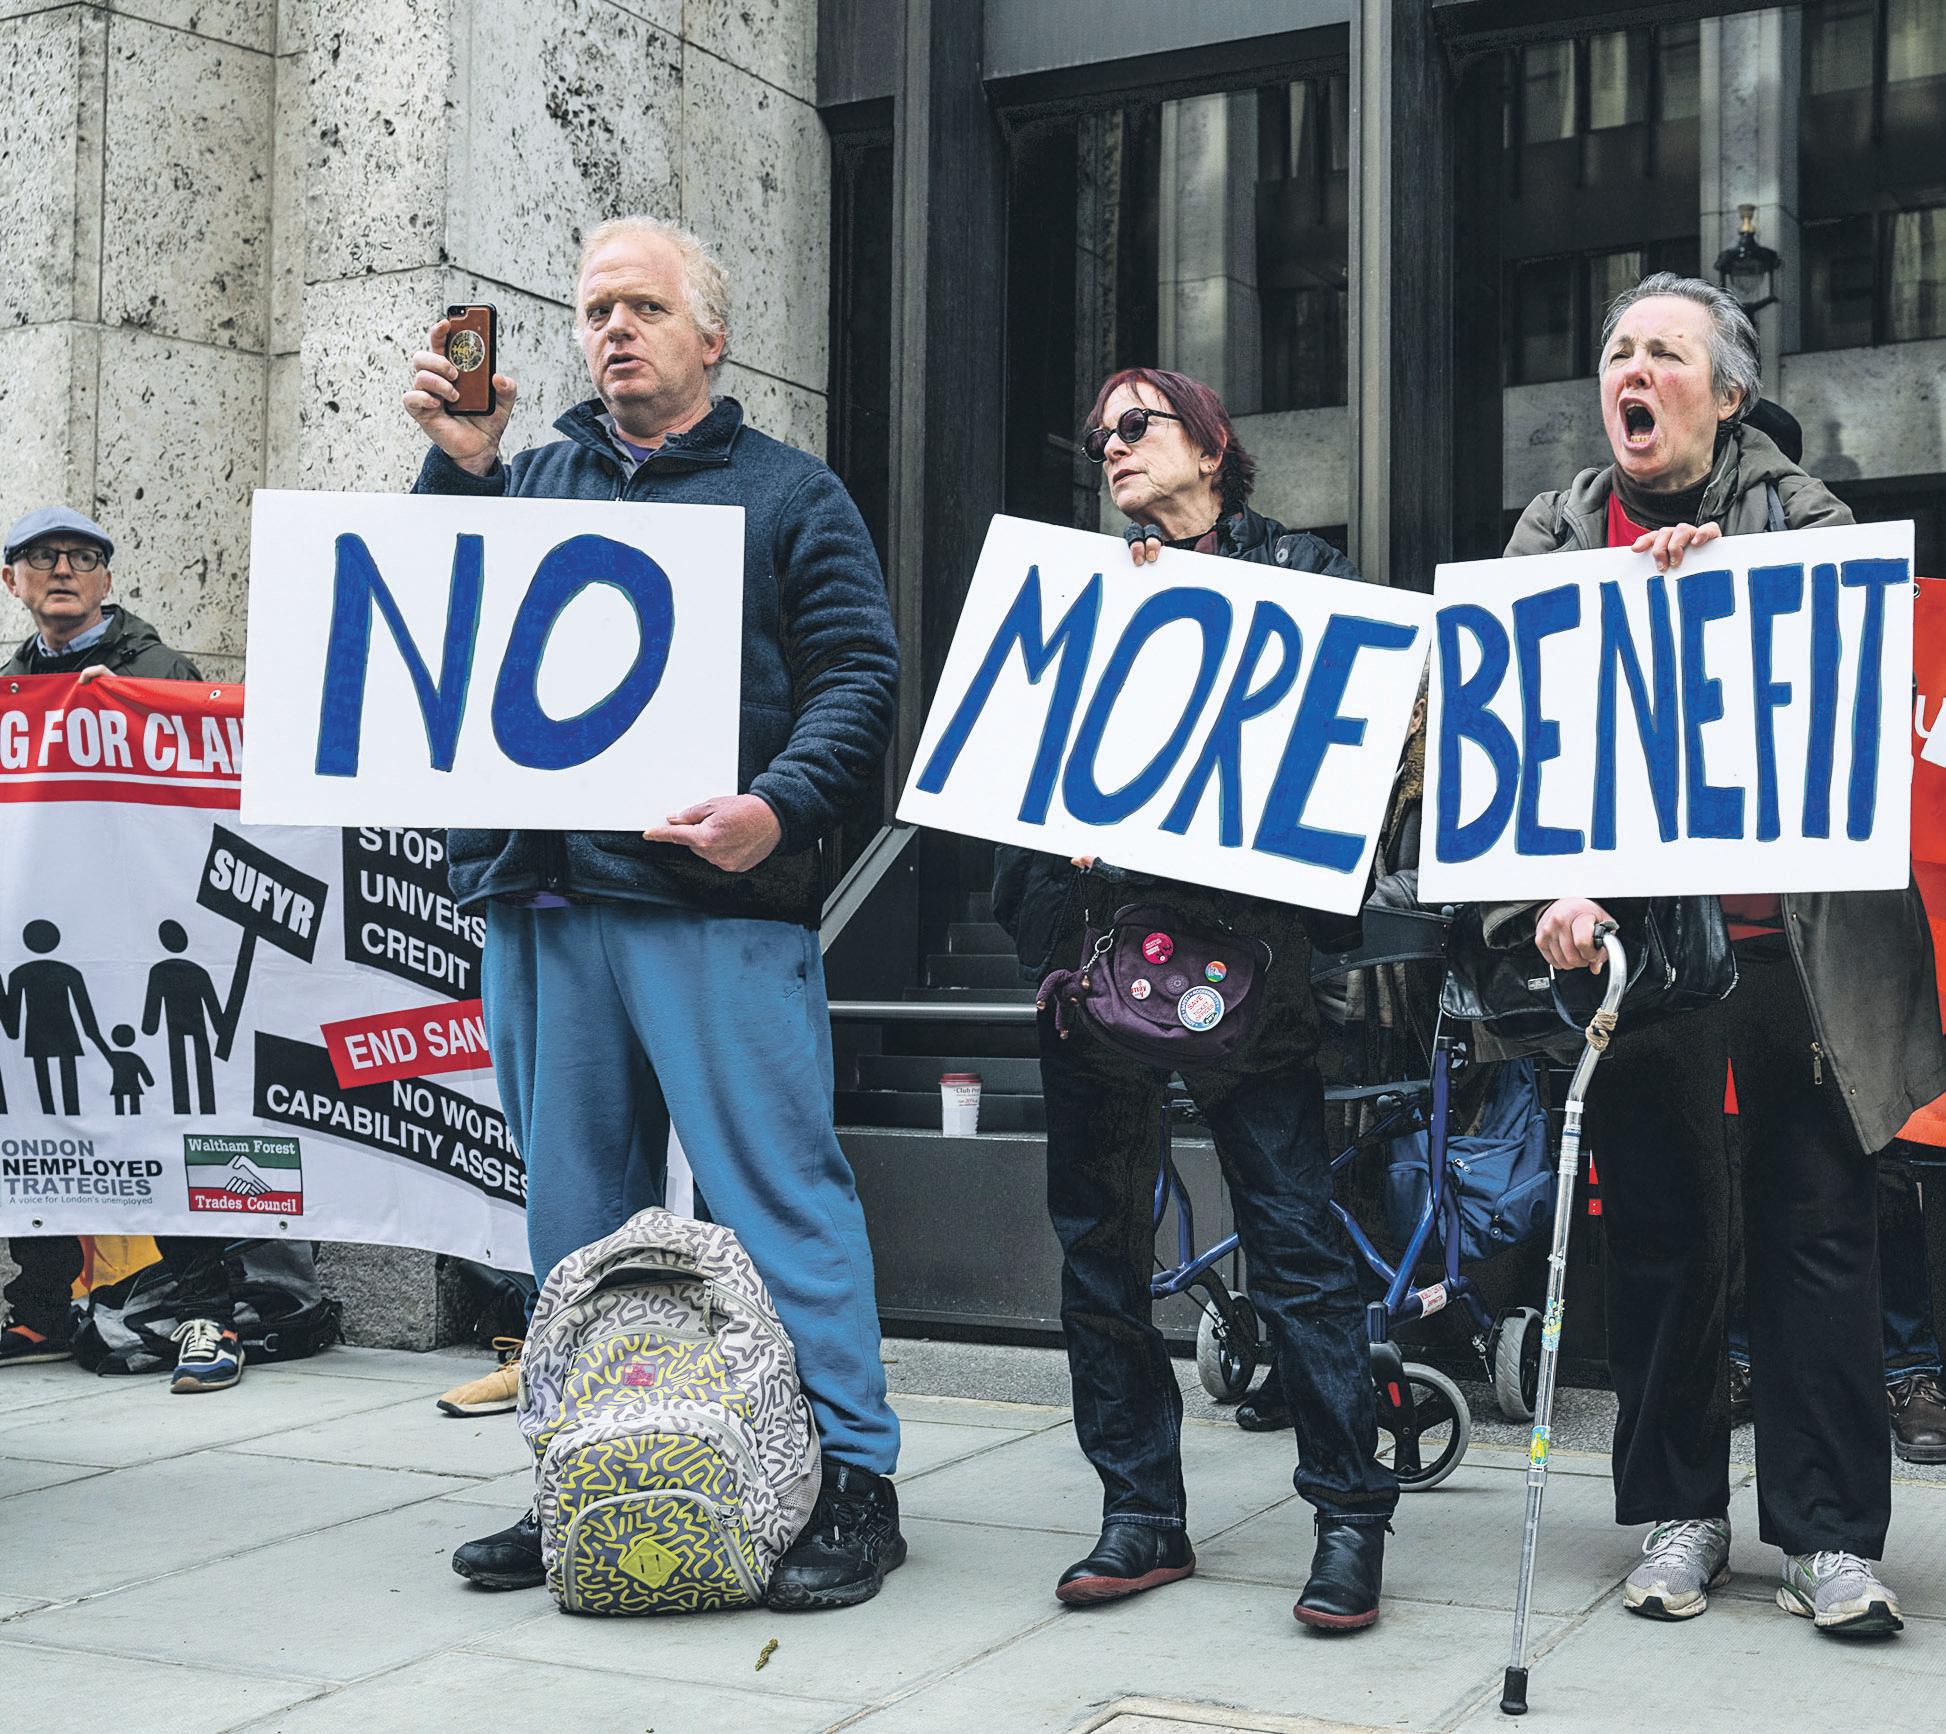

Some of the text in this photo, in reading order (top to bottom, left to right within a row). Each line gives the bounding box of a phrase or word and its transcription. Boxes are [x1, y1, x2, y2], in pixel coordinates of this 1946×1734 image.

[316, 534, 675, 778] NO
[37, 707, 134, 768] FOR
[143, 712, 244, 775] CLAI
[916, 565, 1419, 874] MORE
[1435, 558, 1909, 864] BENEFIT
[358, 826, 444, 870] STOP
[209, 848, 315, 939] SUFYR
[360, 869, 487, 949] UNIVERS
[361, 922, 471, 990] CREDIT
[344, 1016, 490, 1070] END SAN
[266, 1084, 444, 1160] CAPABILITY
[392, 1080, 434, 1118] NO
[187, 1138, 296, 1155] Waltham Forest
[19, 1196, 42, 1204] voice
[45, 1196, 58, 1204] for
[61, 1196, 99, 1204] London's
[102, 1197, 152, 1206] unemployed
[195, 1195, 297, 1212] Trades Council
